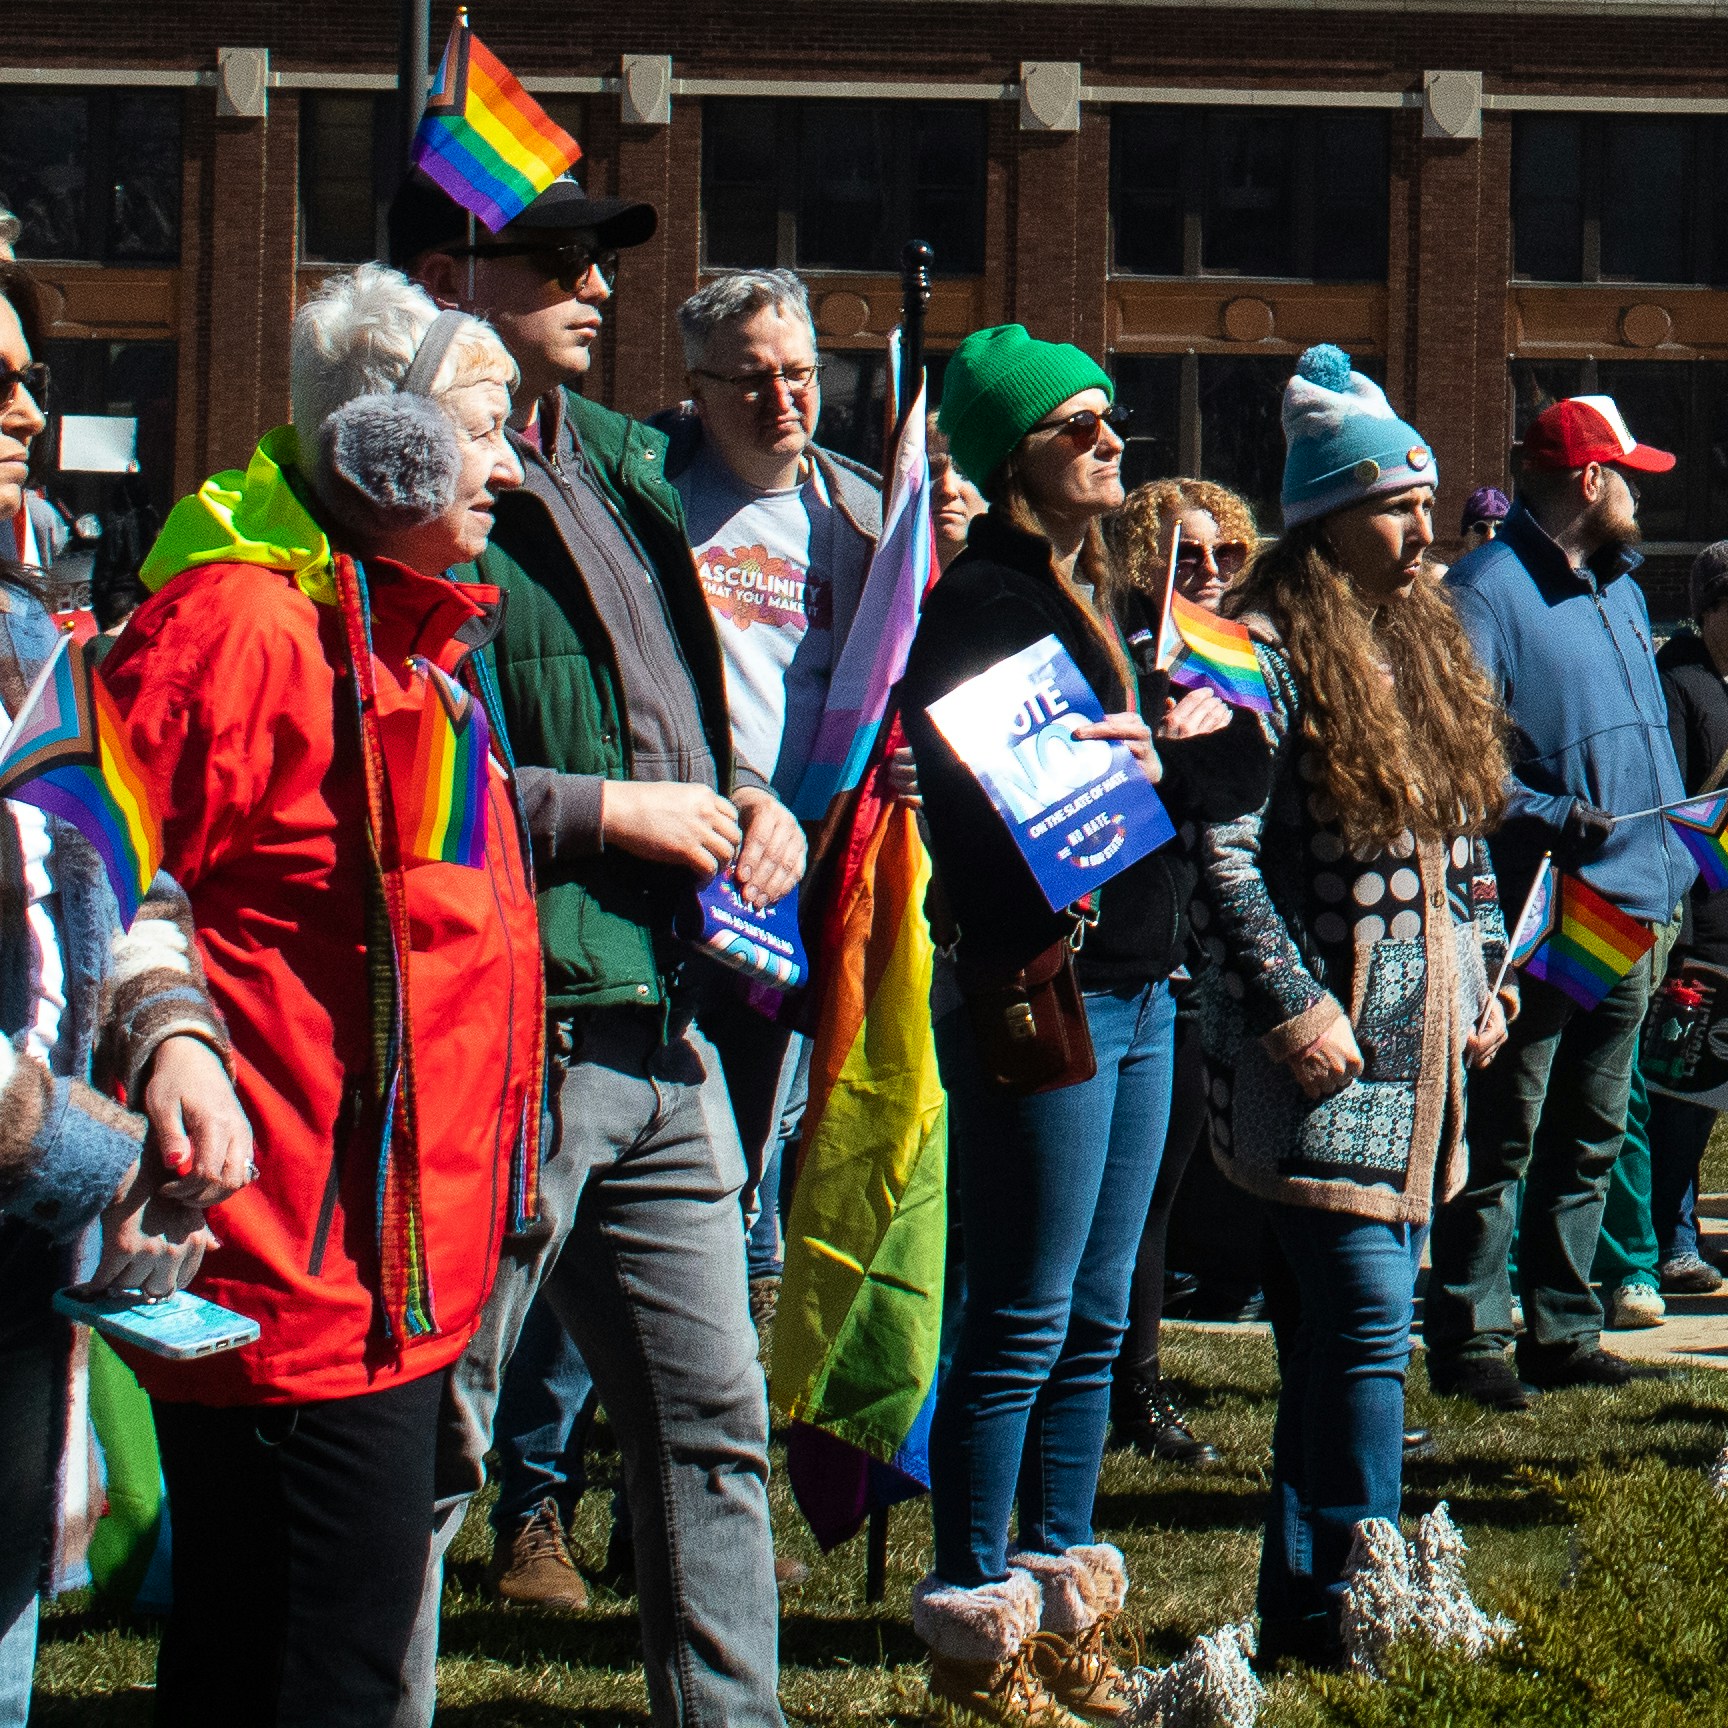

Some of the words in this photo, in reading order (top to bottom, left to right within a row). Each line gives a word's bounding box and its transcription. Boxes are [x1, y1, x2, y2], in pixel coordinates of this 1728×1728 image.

[699, 559, 821, 604] ASCULINITY
[735, 589, 765, 605] YOU
[767, 594, 805, 614] MAKE
[1006, 675, 1070, 737] OTE
[984, 712, 1113, 825] NO
